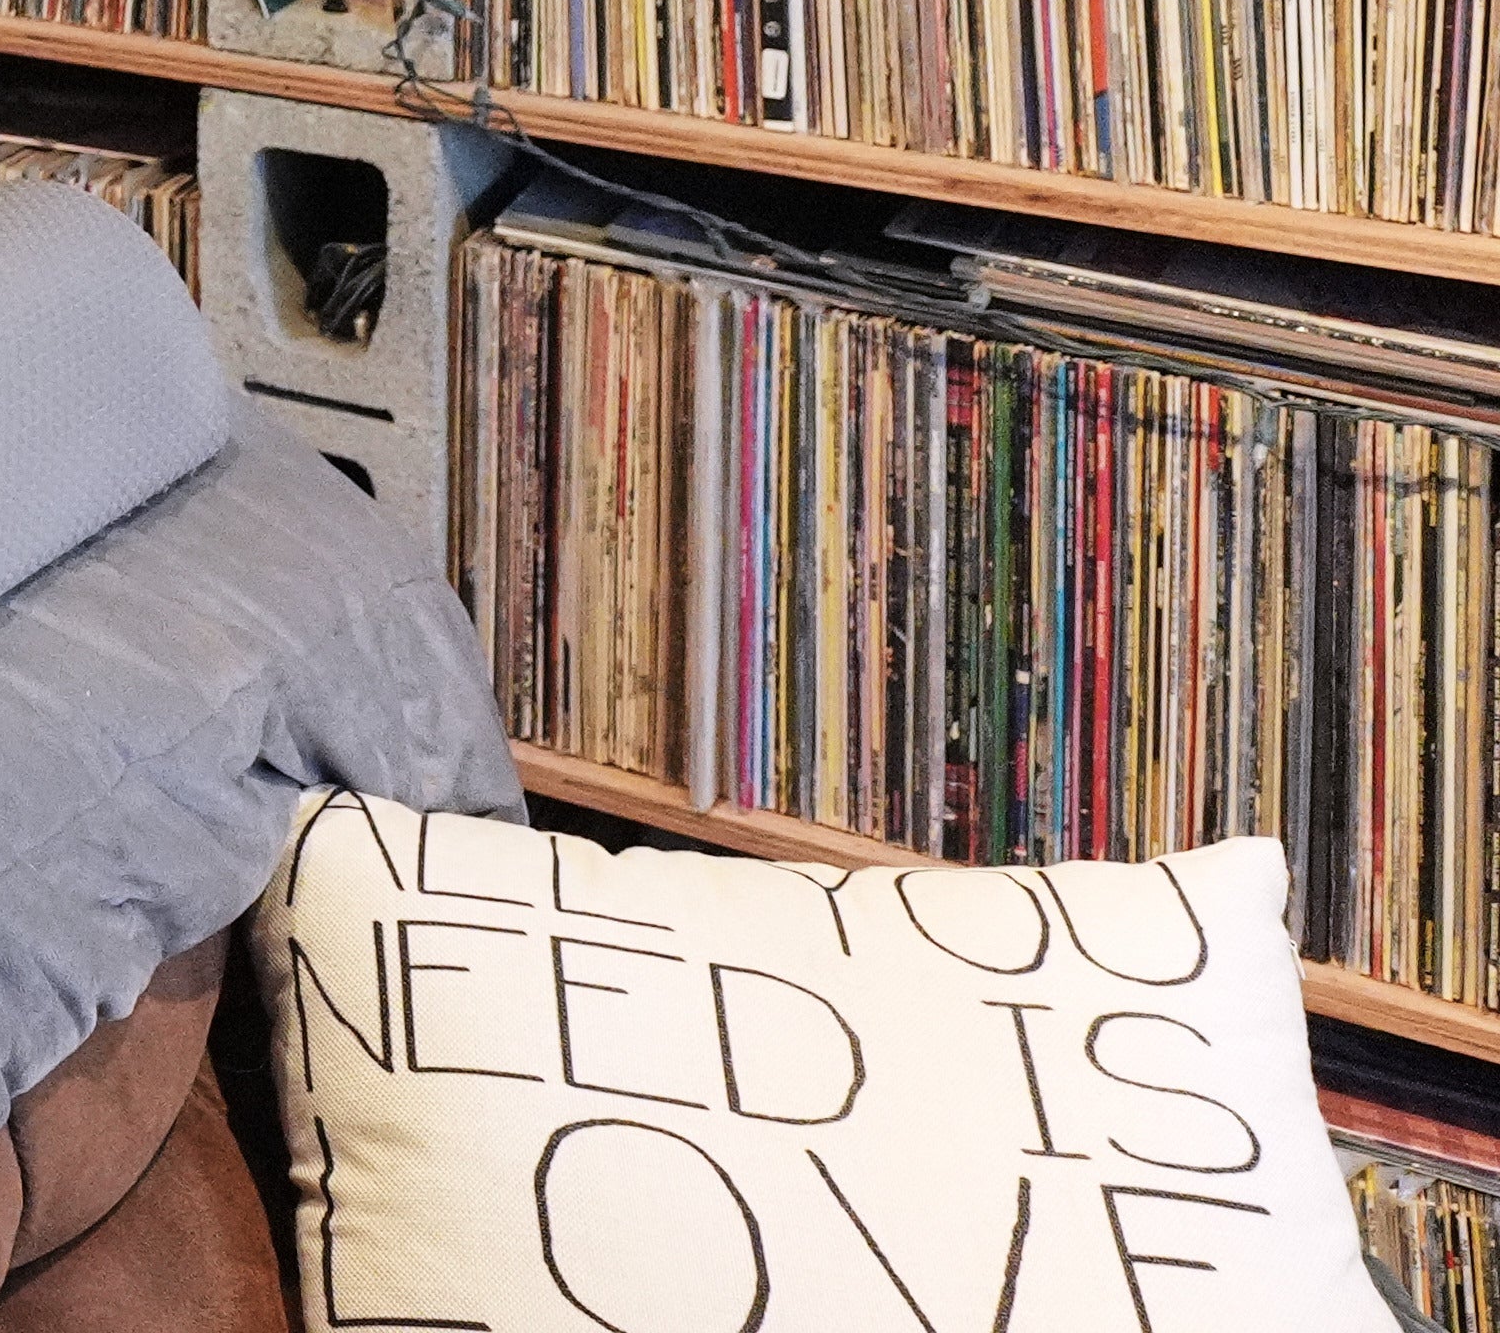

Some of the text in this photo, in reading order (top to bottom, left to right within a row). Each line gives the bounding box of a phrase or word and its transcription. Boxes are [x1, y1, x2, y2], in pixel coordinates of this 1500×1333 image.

[285, 788, 1209, 986] ALL YOU
[288, 920, 1263, 1177] NEED IS
[313, 1116, 1270, 1333] LOVE
